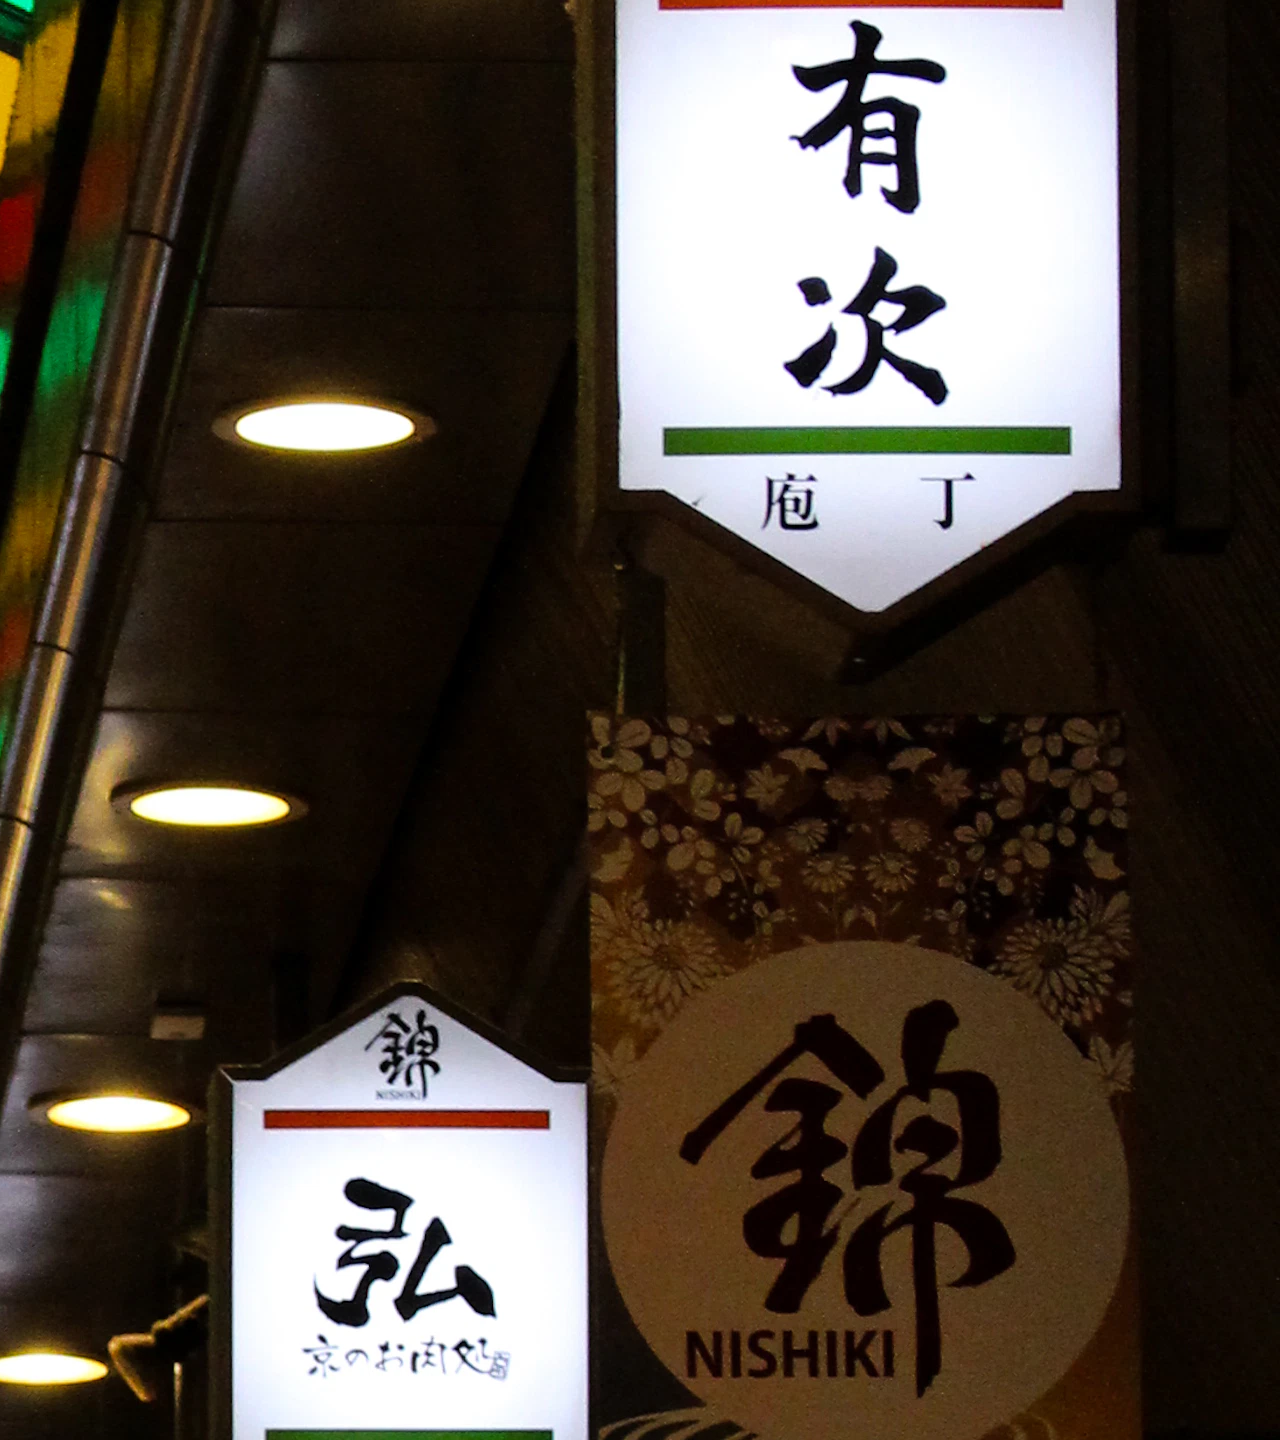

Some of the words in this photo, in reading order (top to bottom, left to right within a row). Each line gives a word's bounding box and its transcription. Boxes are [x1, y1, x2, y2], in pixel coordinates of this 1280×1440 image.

[784, 20, 950, 406] 有次
[761, 472, 976, 532] 庖丁
[364, 1010, 439, 1100] 錦
[313, 1177, 497, 1328] 弘
[679, 1000, 1017, 1399] 錦
[685, 1330, 896, 1379] NISHIKI
